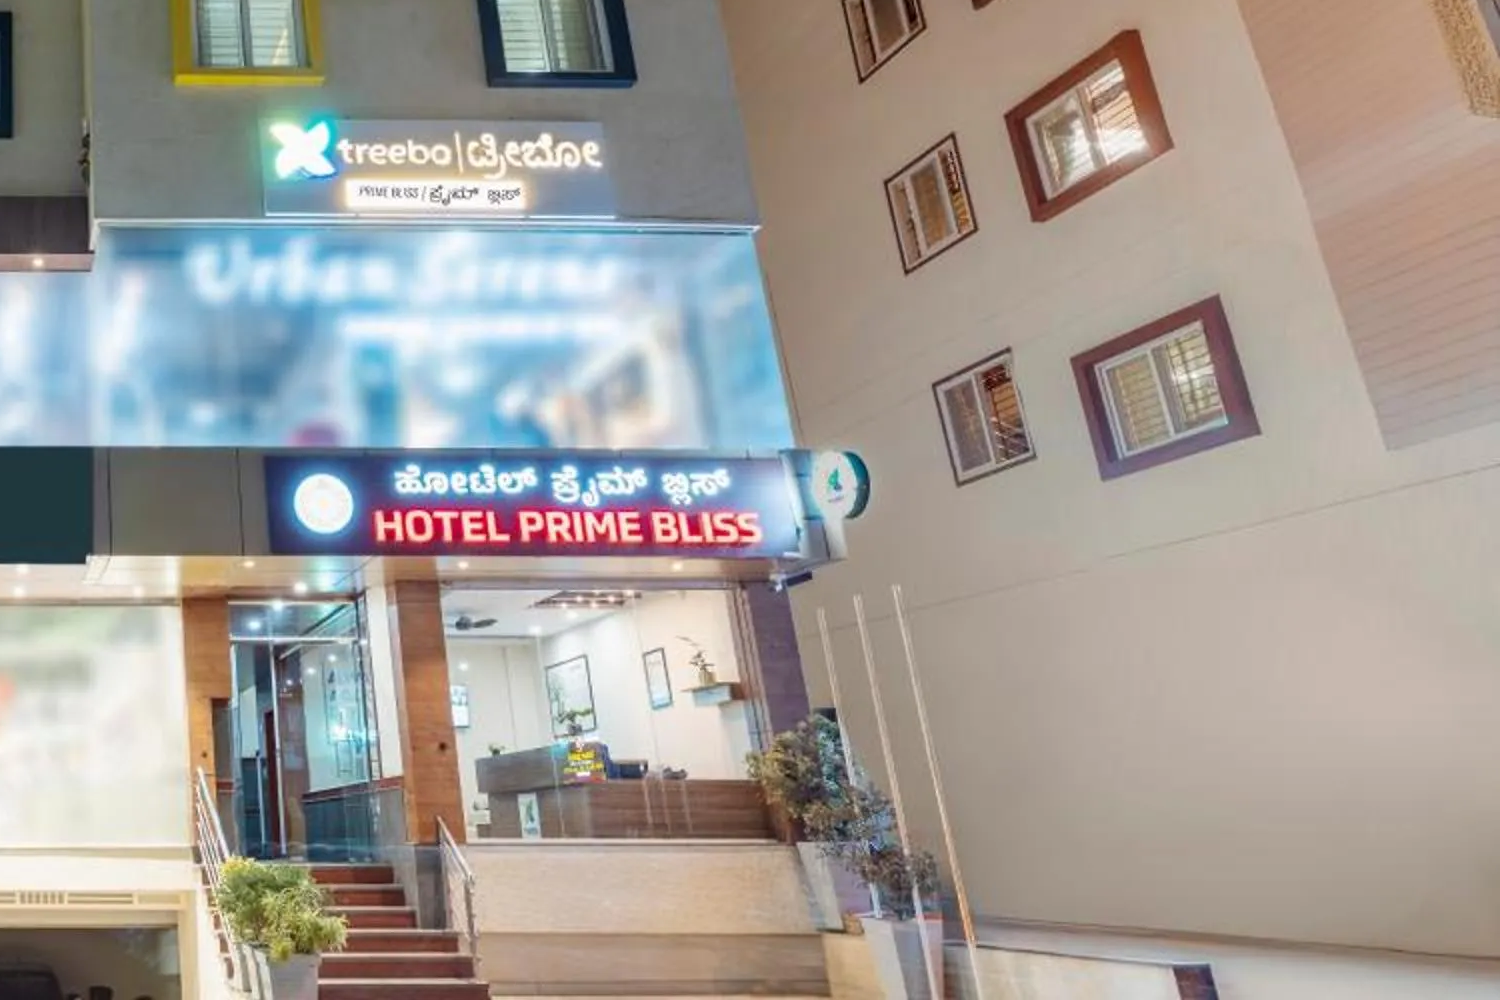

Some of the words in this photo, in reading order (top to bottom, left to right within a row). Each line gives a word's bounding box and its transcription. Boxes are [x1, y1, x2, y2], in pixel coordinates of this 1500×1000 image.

[336, 138, 451, 166] treebo
[393, 462, 539, 495] ಹೋಟೆಲ್
[373, 509, 511, 543] HOTEL
[518, 510, 644, 543] PRIME
[650, 511, 763, 544] BLISS
